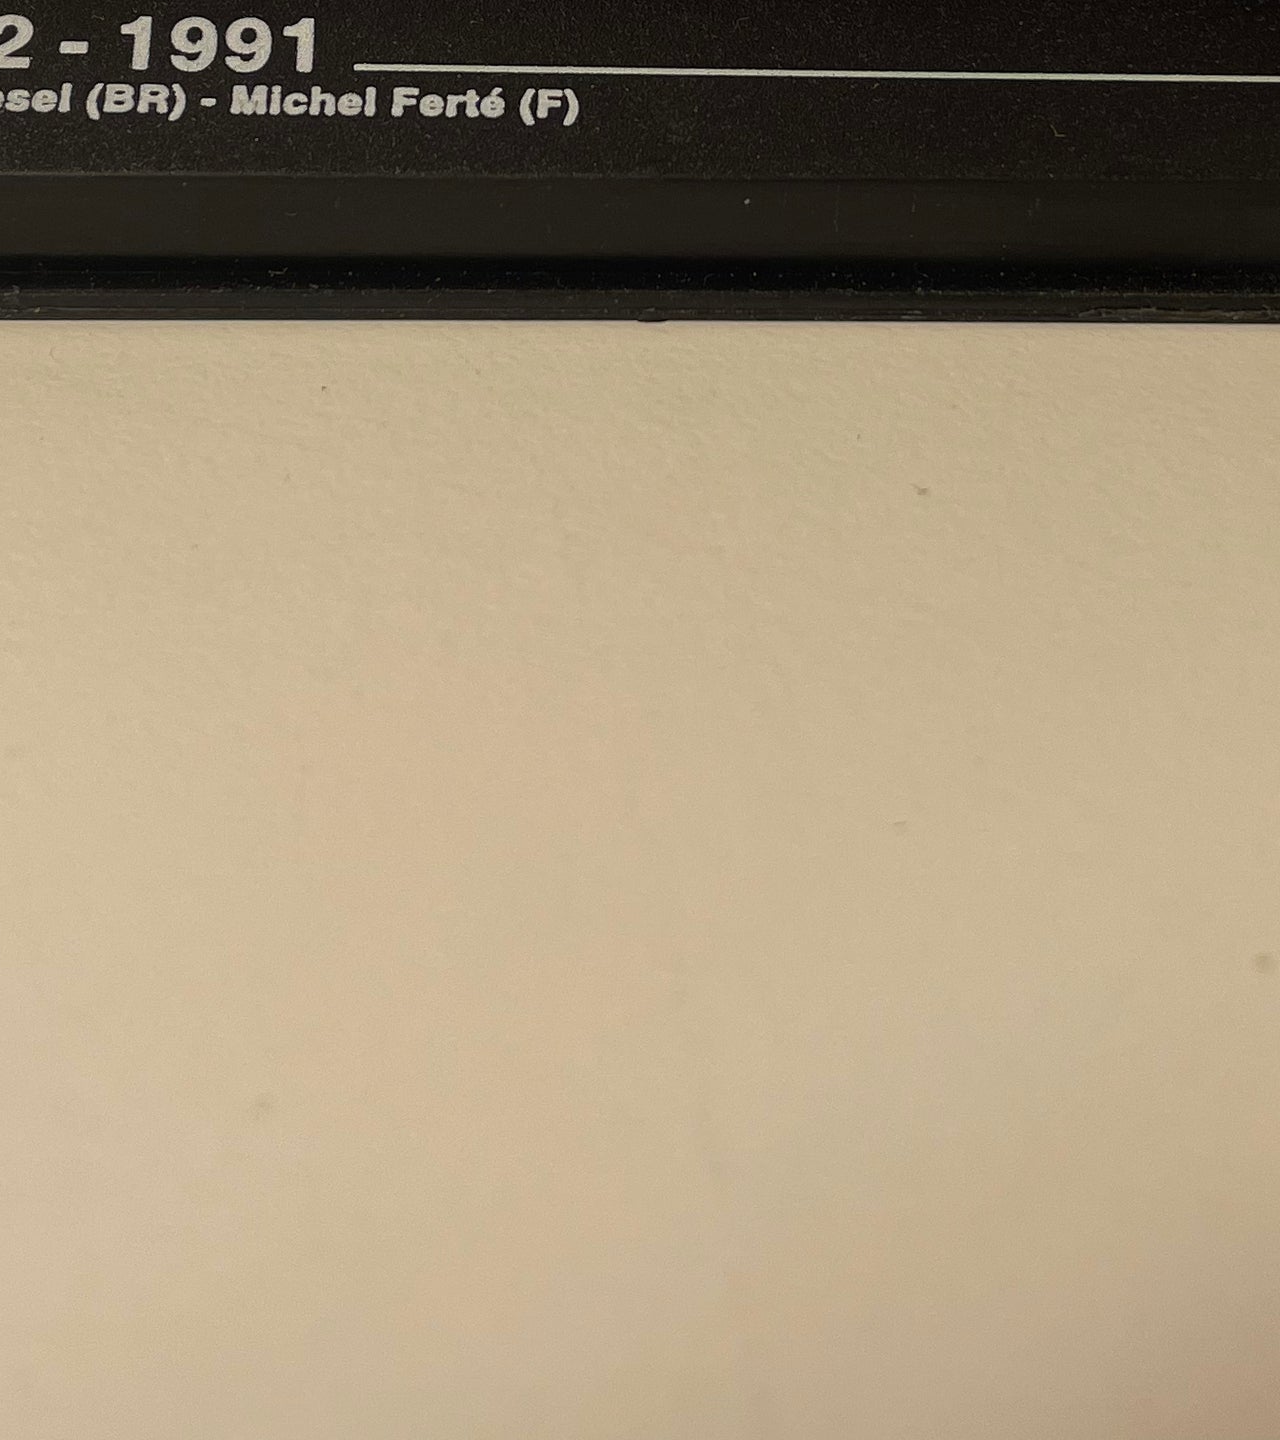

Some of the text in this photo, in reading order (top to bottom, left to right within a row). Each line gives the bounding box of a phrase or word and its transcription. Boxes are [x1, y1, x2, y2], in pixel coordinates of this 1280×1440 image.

[120, 15, 315, 74] 1991
[85, 82, 187, 122] (BR)
[229, 84, 377, 117] Michel
[390, 86, 506, 118] Ferté
[519, 88, 580, 127] (F)
